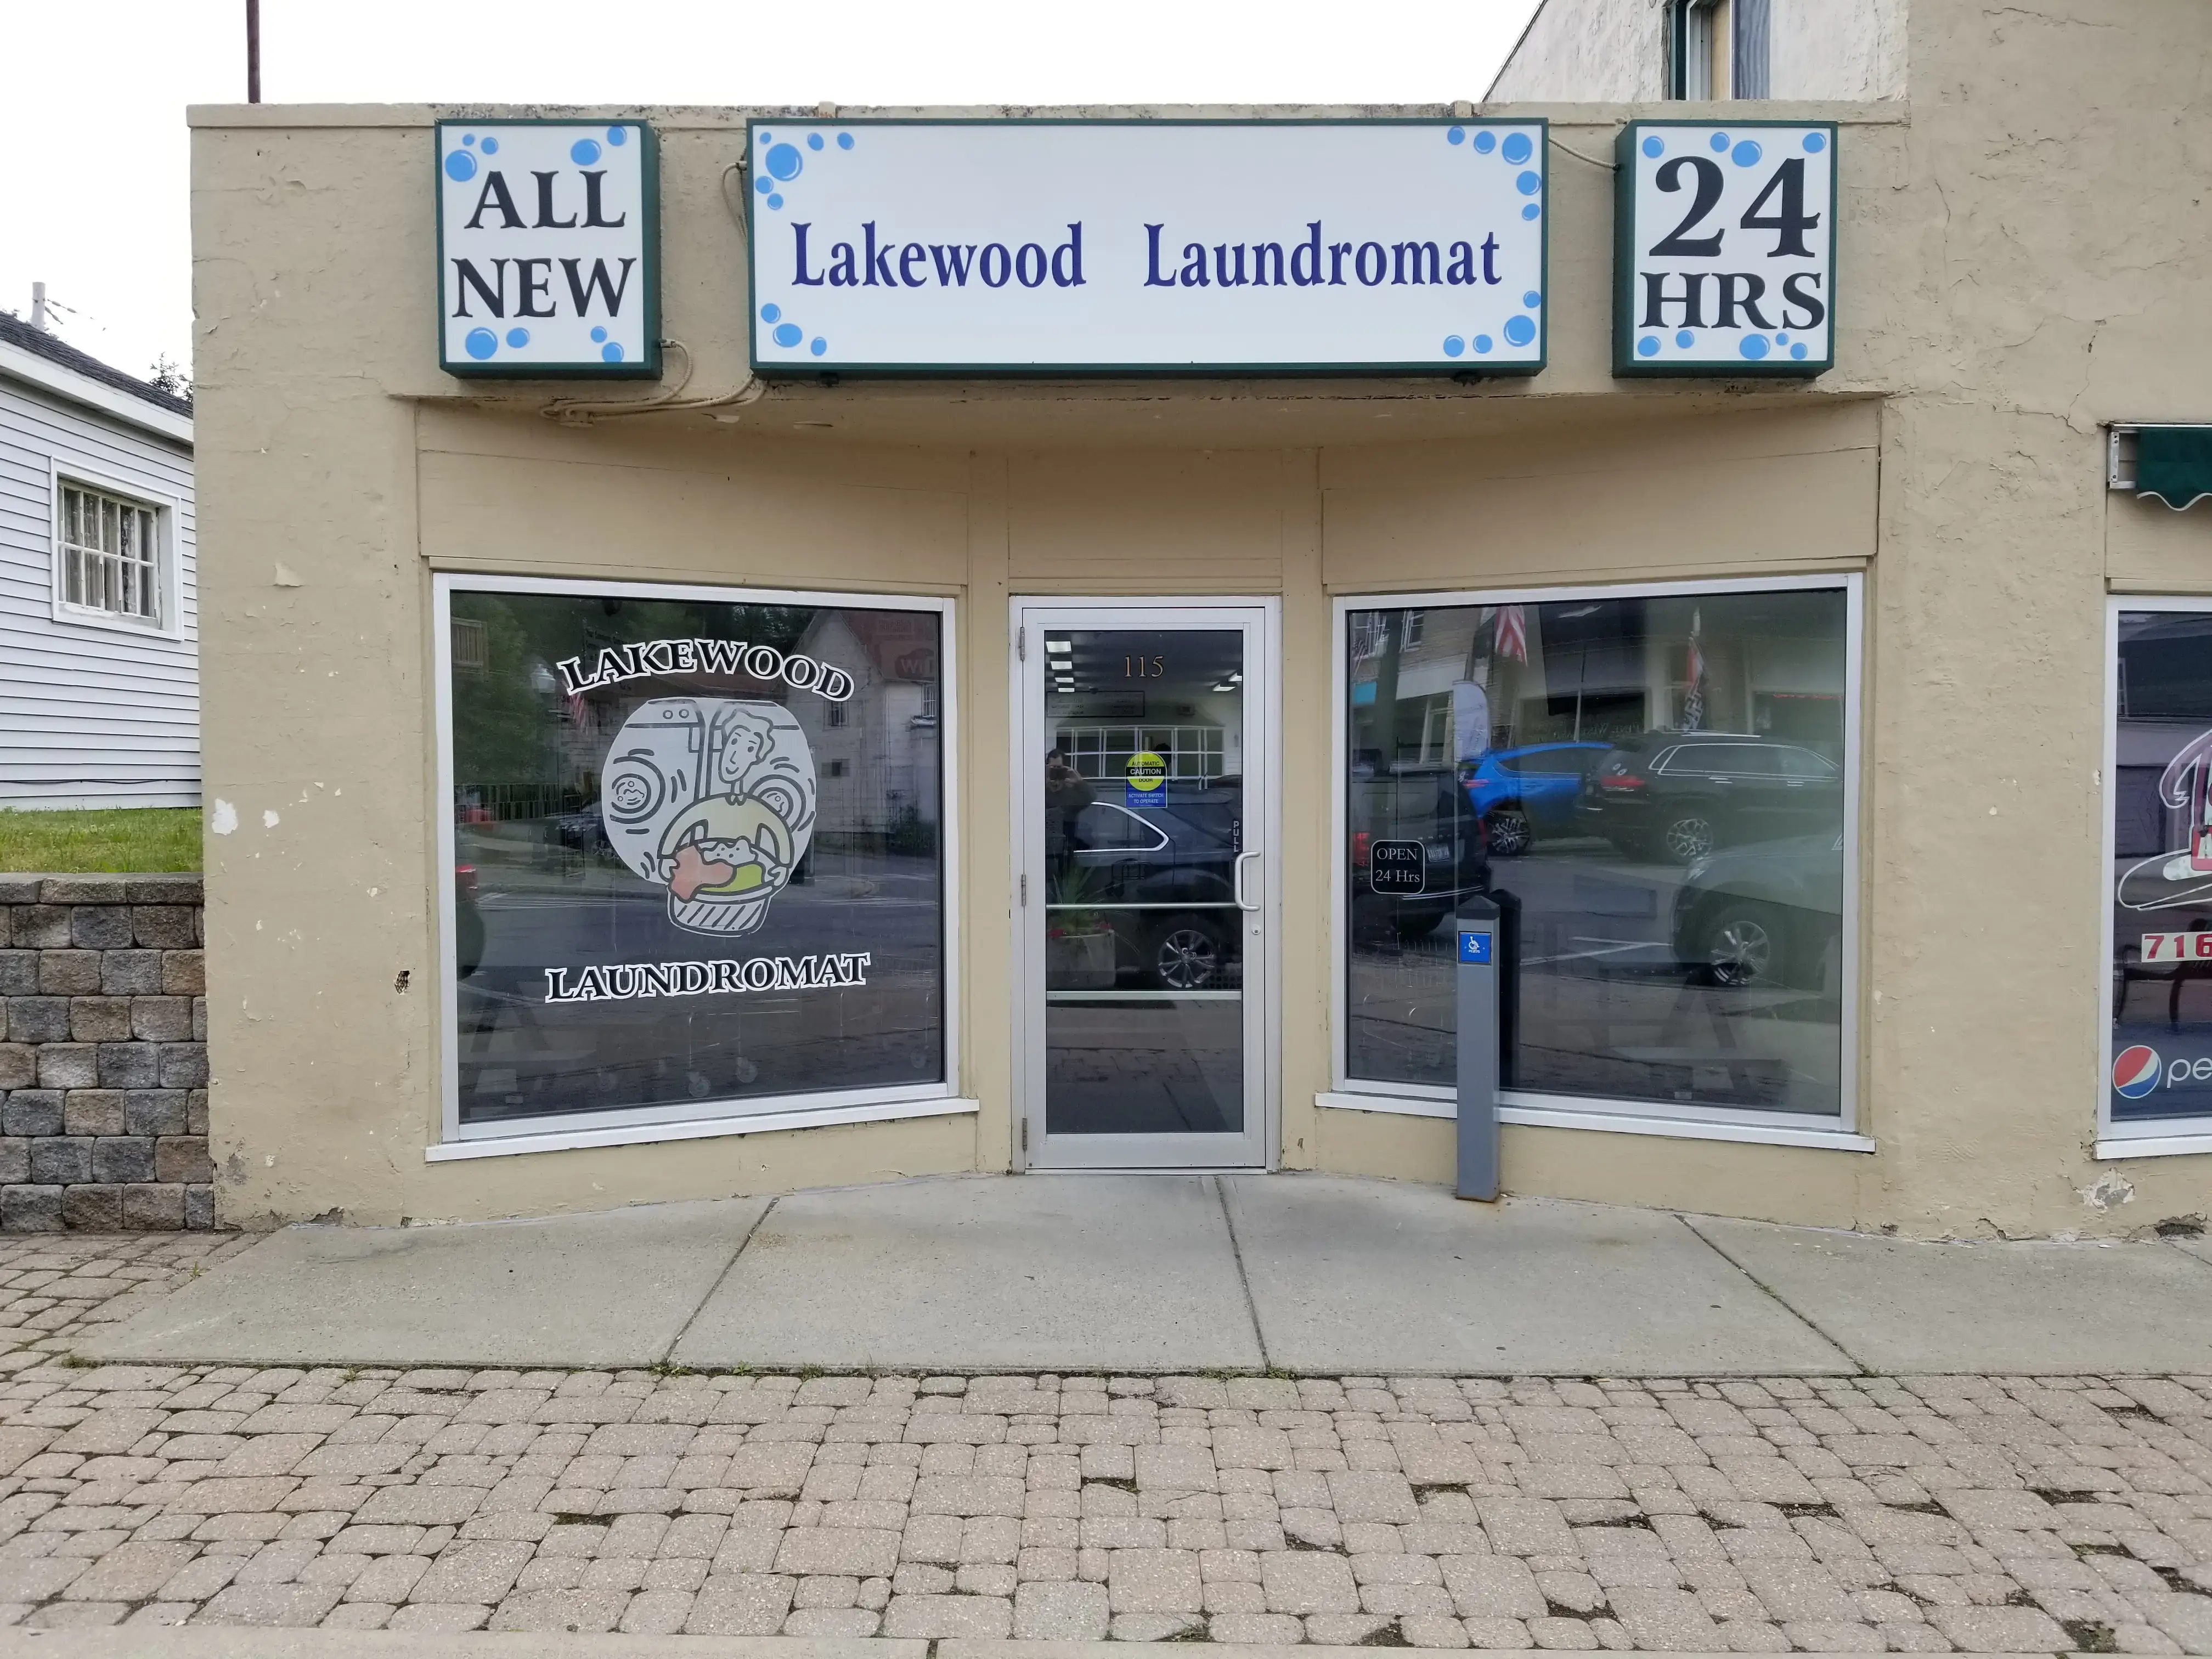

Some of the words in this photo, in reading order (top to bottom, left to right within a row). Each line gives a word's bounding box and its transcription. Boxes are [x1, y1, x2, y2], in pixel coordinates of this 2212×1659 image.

[464, 170, 626, 229] ALL
[1649, 156, 1821, 258] 24
[791, 220, 1086, 287] Lakewood
[1143, 219, 1502, 287] Laundromat
[451, 257, 637, 318] NEW
[1639, 272, 1825, 330] HRS
[556, 638, 855, 702] LAKEWOOD
[1124, 655, 1164, 678] 115
[1375, 870, 1391, 882] 24
[1396, 870, 1420, 882] Hrs
[1377, 848, 1418, 860] OPEN
[2145, 934, 2212, 959] 716
[545, 952, 871, 1003] LAUNDROMAT
[2167, 1058, 2212, 1088] pe
